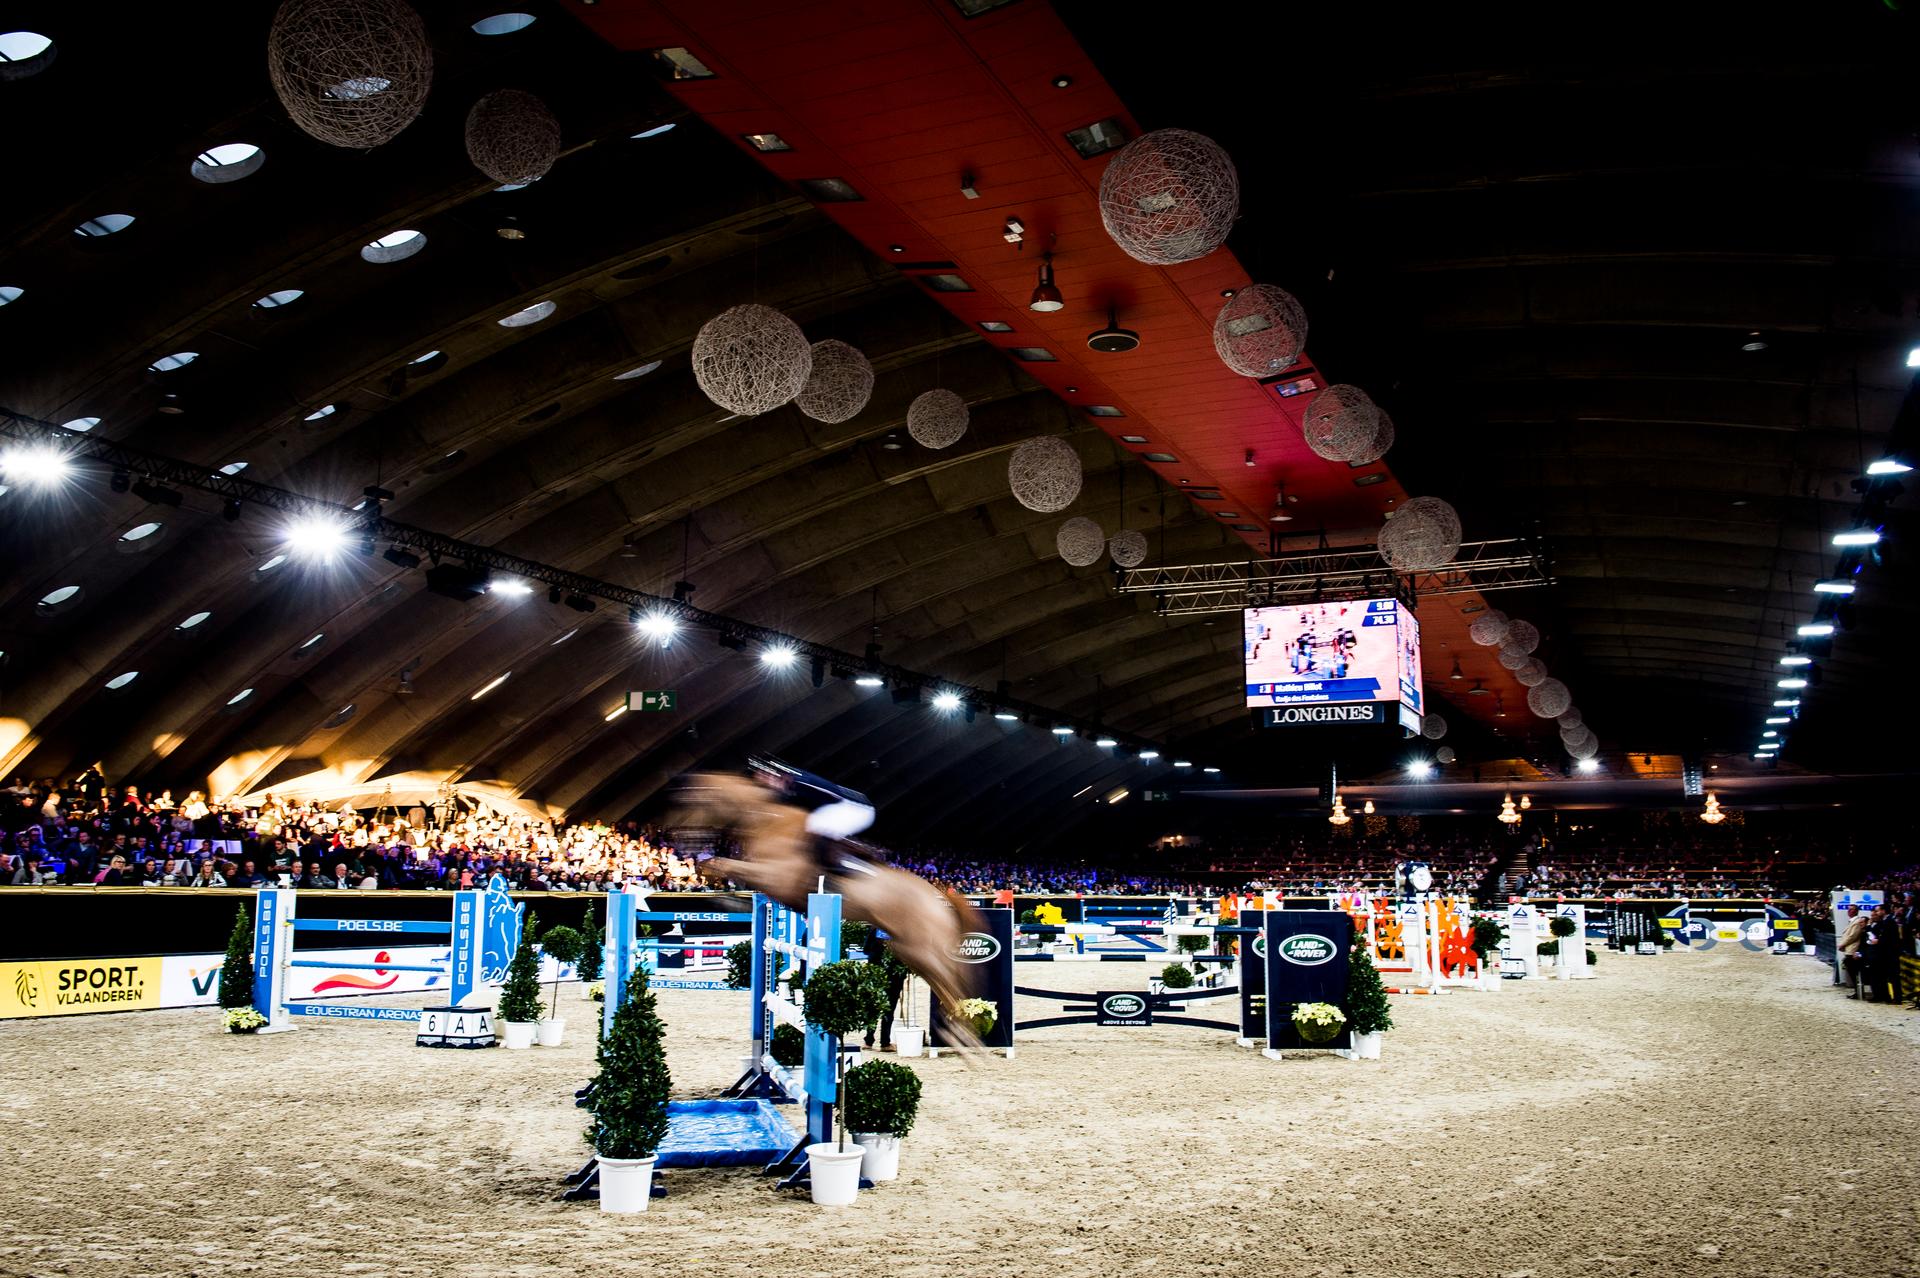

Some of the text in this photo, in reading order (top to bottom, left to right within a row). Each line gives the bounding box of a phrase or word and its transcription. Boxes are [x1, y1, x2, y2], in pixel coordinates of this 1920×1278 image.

[1273, 705, 1374, 723] LONGINES
[674, 912, 728, 922] POELS.BE
[337, 920, 403, 932] POELS.BE
[259, 899, 271, 978] POELS.BE
[458, 901, 470, 985] POELS.BE
[957, 939, 983, 948] AND
[1290, 940, 1319, 949] LAND
[960, 947, 990, 956] ROVER
[1292, 949, 1327, 958] ROVER
[58, 966, 144, 990] SPORT.
[649, 980, 709, 989] EQUESTRIAN
[1152, 982, 1165, 995] 12
[57, 989, 142, 1005] VLAANDEREN
[305, 1005, 423, 1020] EQUESTRIAN ARENAS
[1113, 1004, 1138, 1012] ROVER
[428, 1014, 436, 1032] 6
[454, 1016, 465, 1034] A
[479, 1015, 488, 1033] A
